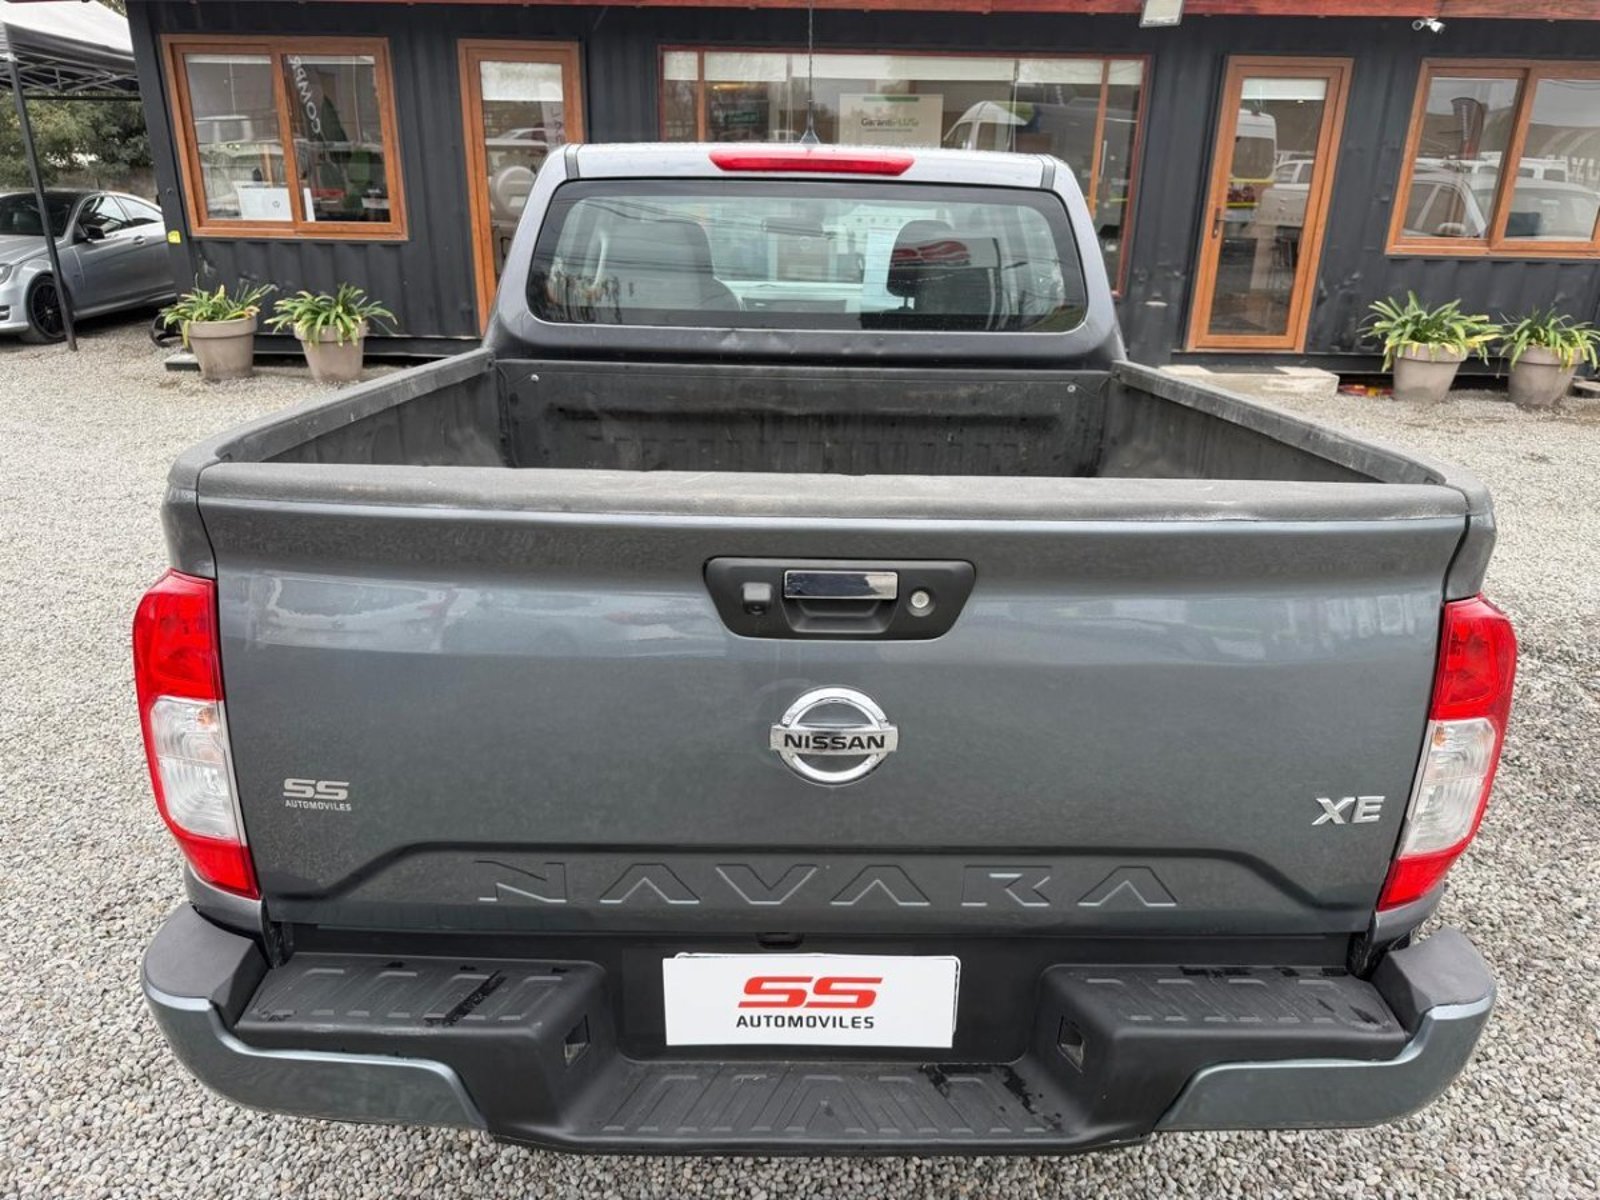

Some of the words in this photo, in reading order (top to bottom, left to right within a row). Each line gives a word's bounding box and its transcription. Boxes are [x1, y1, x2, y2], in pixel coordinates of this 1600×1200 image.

[784, 733, 885, 750] NISSAN
[282, 778, 350, 801] SS
[284, 799, 352, 812] AUTOMOVILES
[1311, 795, 1386, 826] XE
[474, 859, 1178, 907] NAVARA
[738, 976, 883, 1009] SS
[736, 1014, 875, 1030] AUTOMOVILES
